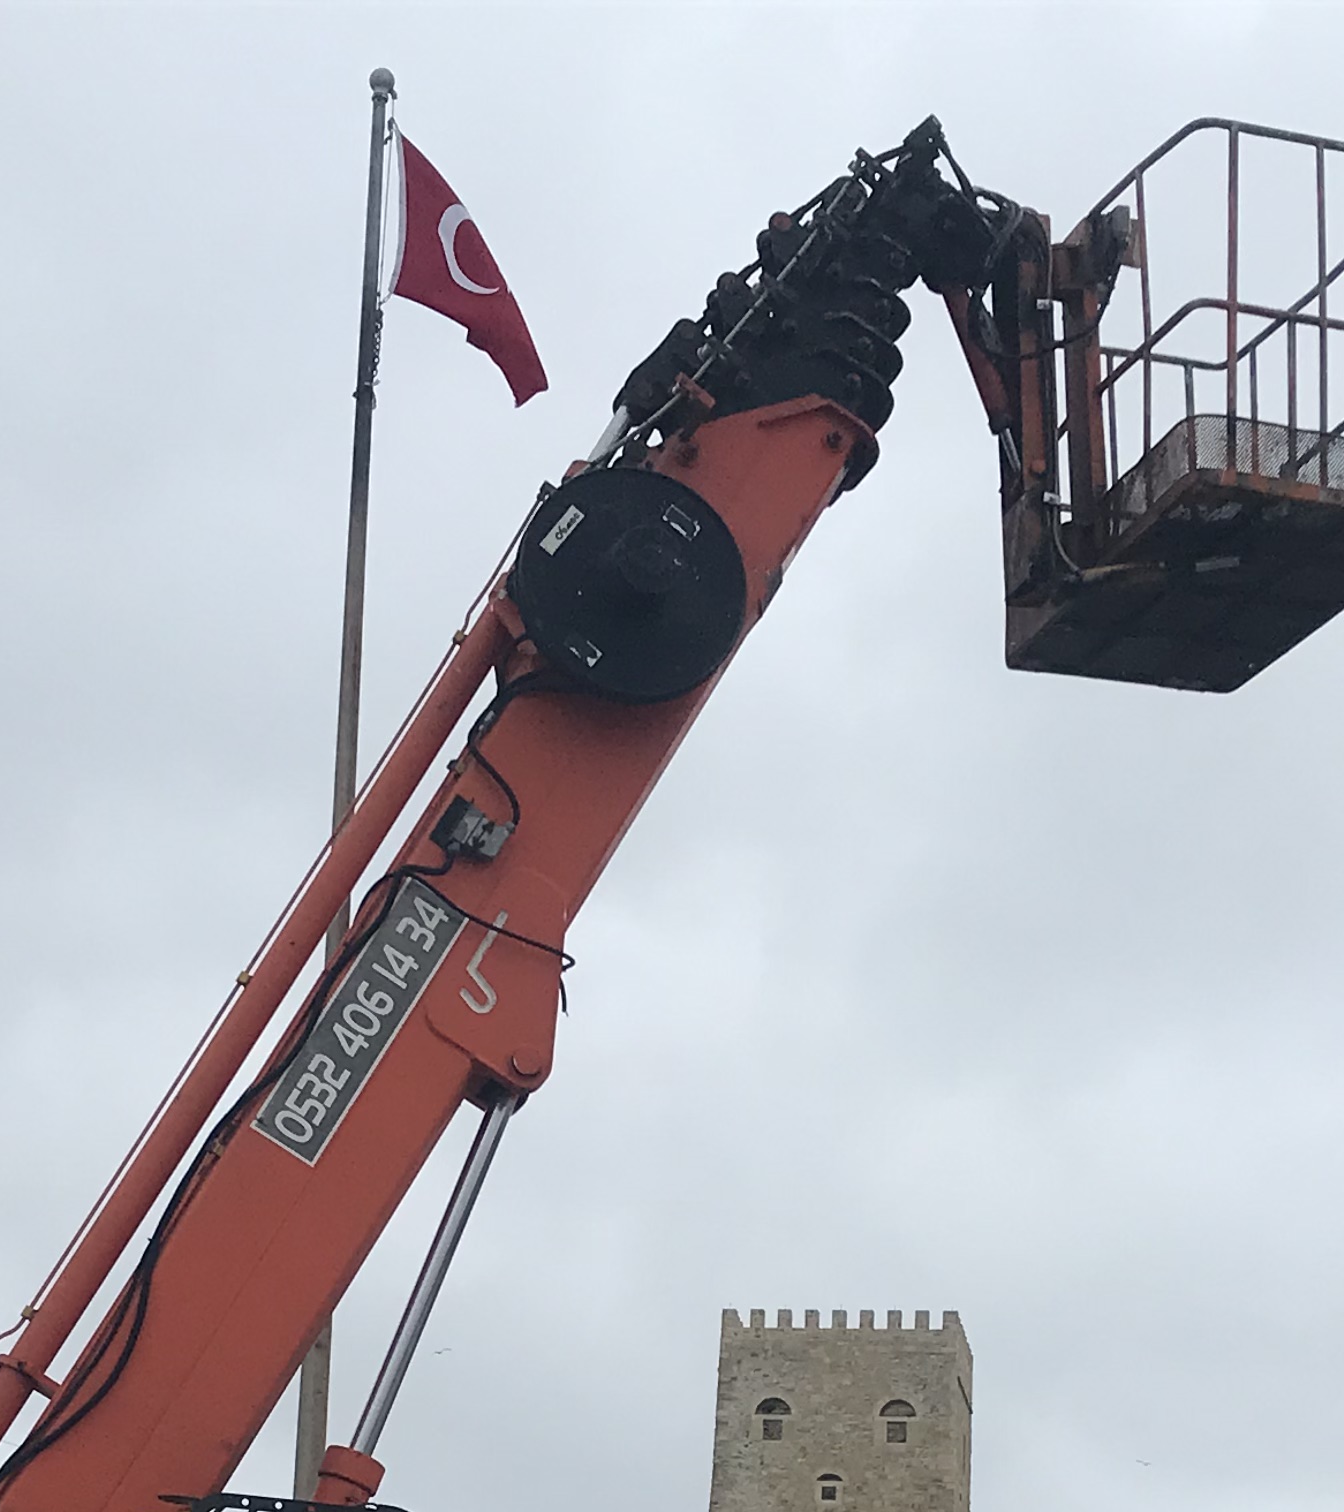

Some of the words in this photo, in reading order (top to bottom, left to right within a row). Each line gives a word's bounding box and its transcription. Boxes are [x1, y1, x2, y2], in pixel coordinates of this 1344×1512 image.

[274, 1053, 351, 1143] 0532
[332, 980, 395, 1058] 406
[371, 944, 419, 990] 14
[395, 896, 450, 952] 34
